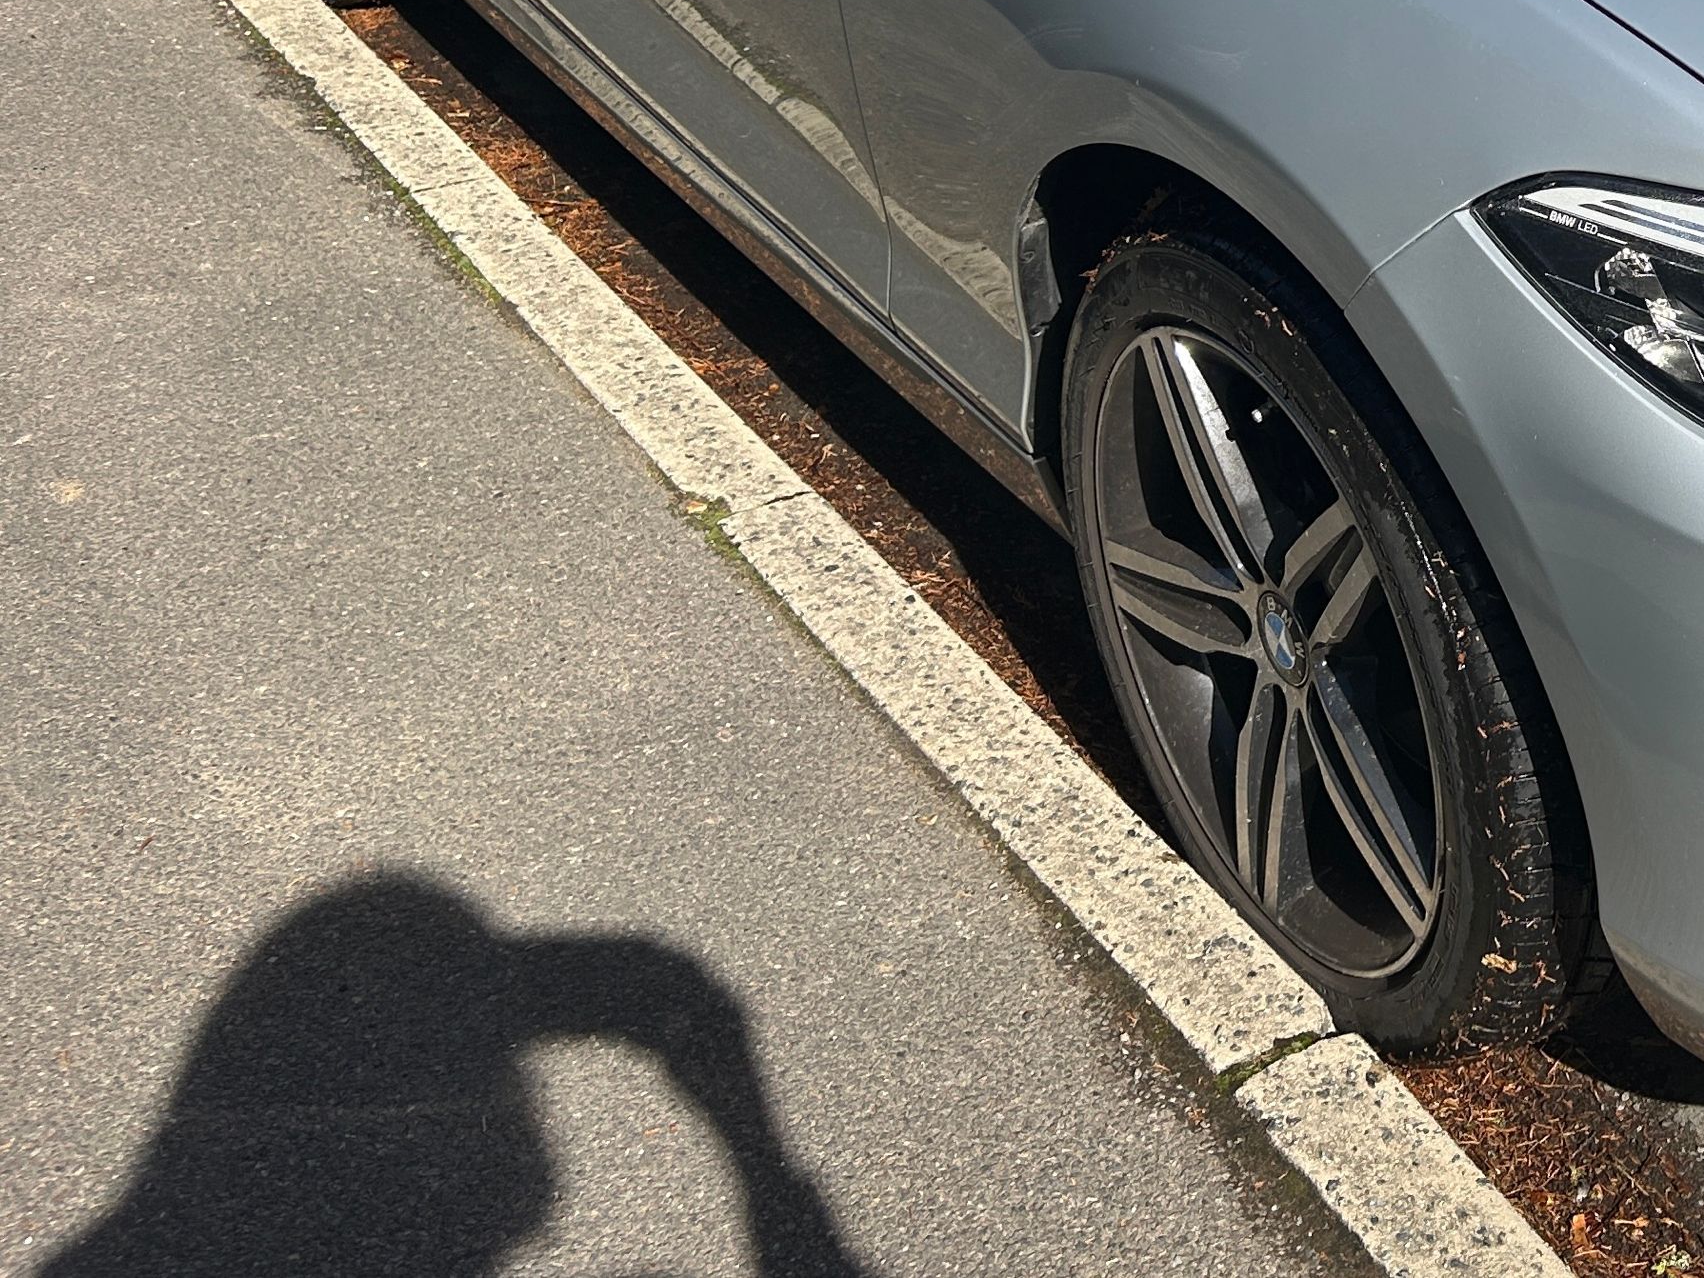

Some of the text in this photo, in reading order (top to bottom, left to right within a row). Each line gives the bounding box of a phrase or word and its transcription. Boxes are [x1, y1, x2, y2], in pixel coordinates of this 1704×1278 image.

[1549, 210, 1598, 234] BMW LED
[1266, 596, 1305, 658] BMW
